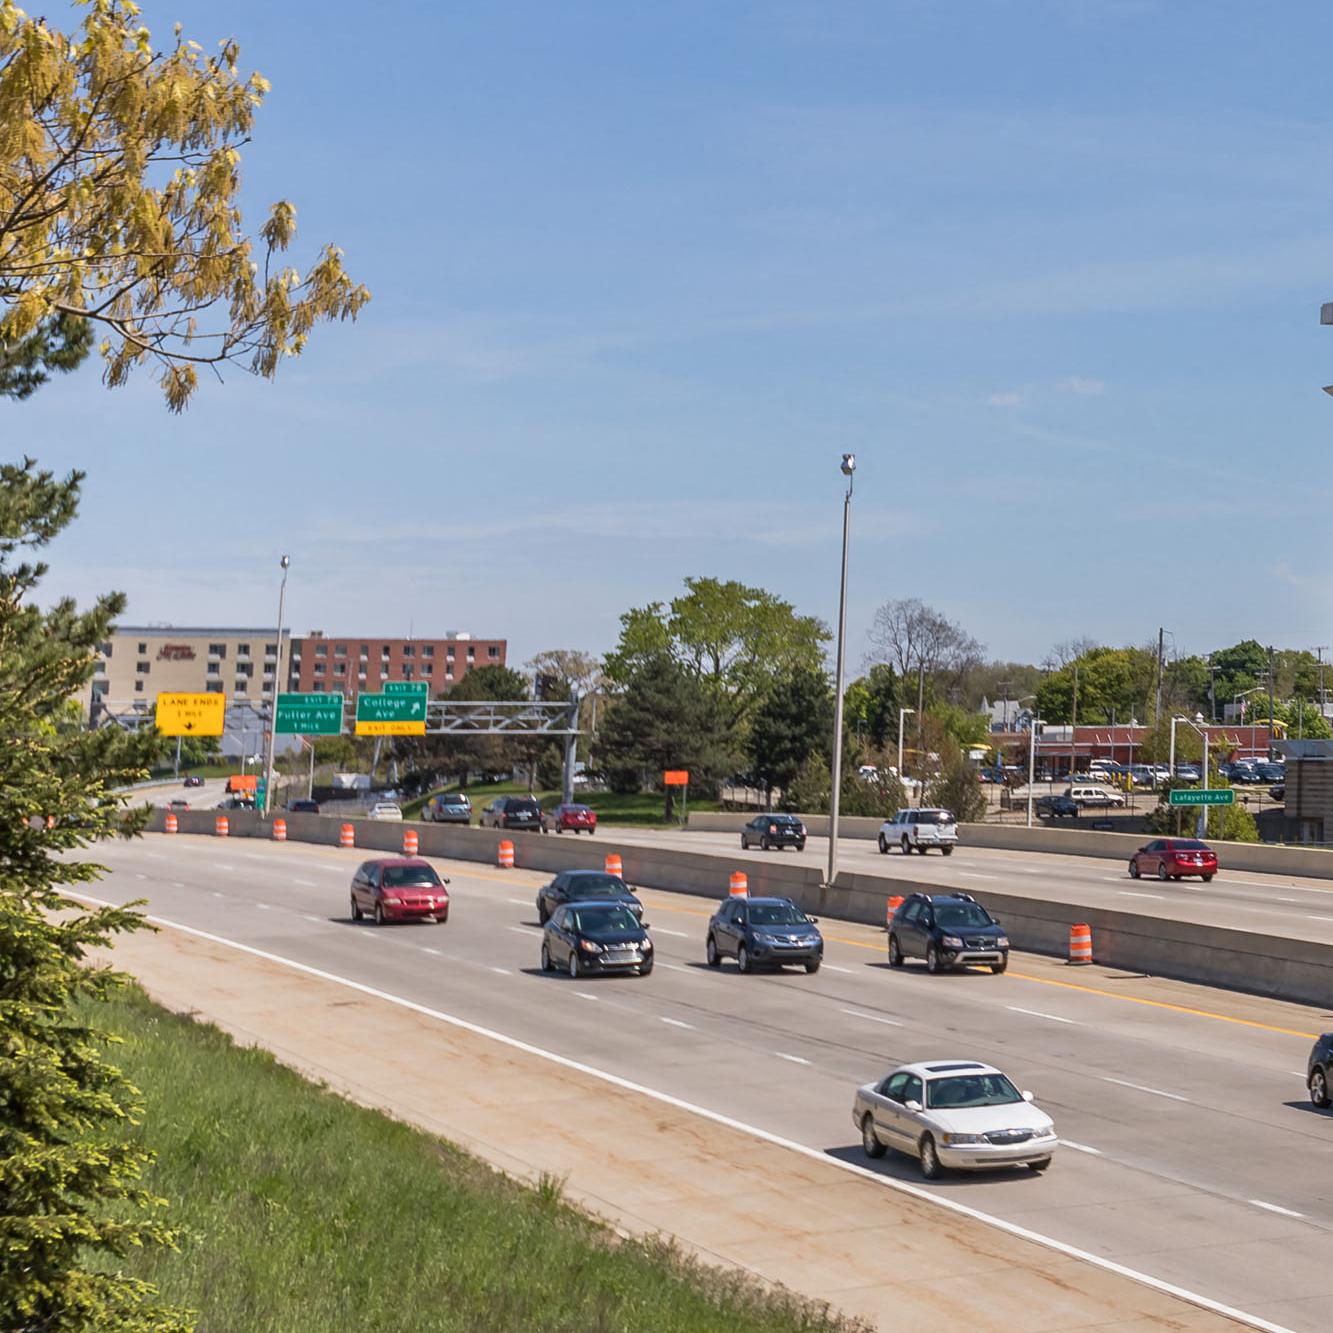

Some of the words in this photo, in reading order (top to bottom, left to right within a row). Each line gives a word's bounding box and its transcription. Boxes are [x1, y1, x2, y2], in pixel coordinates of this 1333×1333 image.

[163, 698, 187, 706] LANE
[193, 698, 218, 706] ENDS
[363, 697, 406, 709] College
[315, 710, 336, 720] Ave
[375, 709, 395, 718] Ave
[1174, 793, 1212, 802] Lafayette
[1214, 793, 1230, 801] Ave
